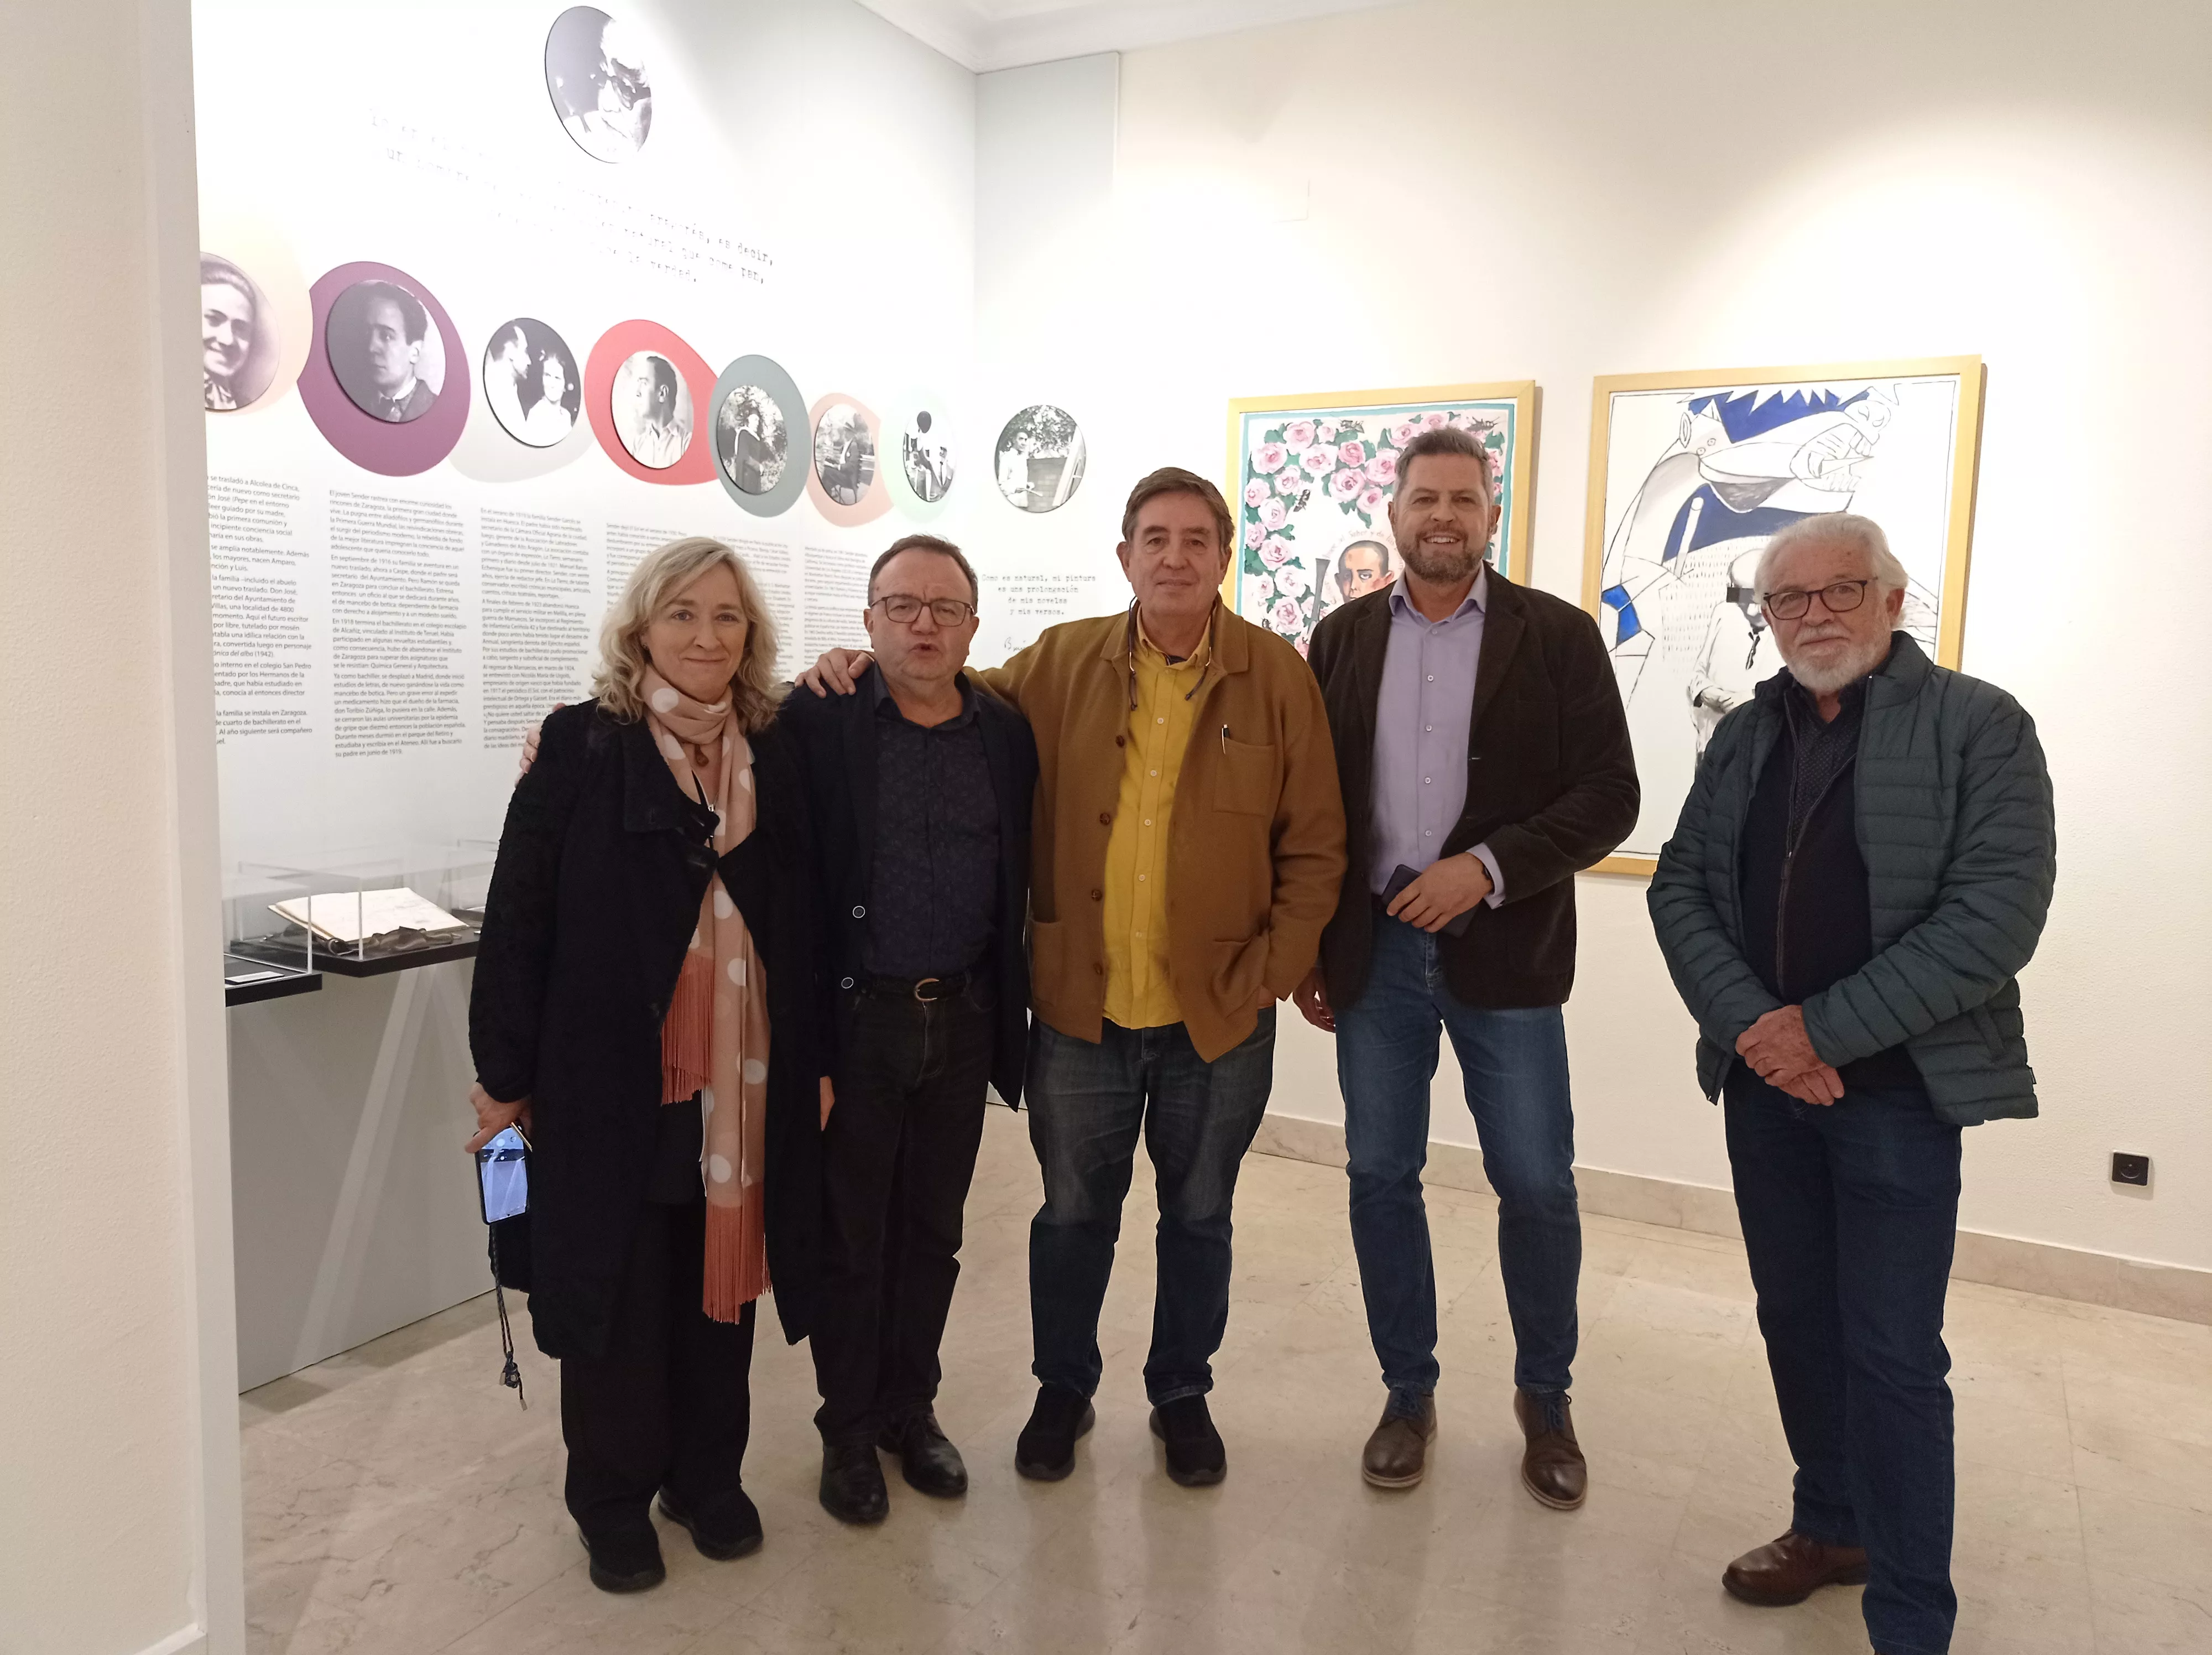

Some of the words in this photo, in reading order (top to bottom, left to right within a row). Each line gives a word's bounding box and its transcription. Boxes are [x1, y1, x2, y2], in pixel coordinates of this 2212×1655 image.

[738, 242, 773, 267] decir,
[741, 267, 764, 284] pan,
[218, 476, 243, 485] trasladó
[250, 479, 272, 488] Alcolea
[1027, 585, 1078, 593] prolongación
